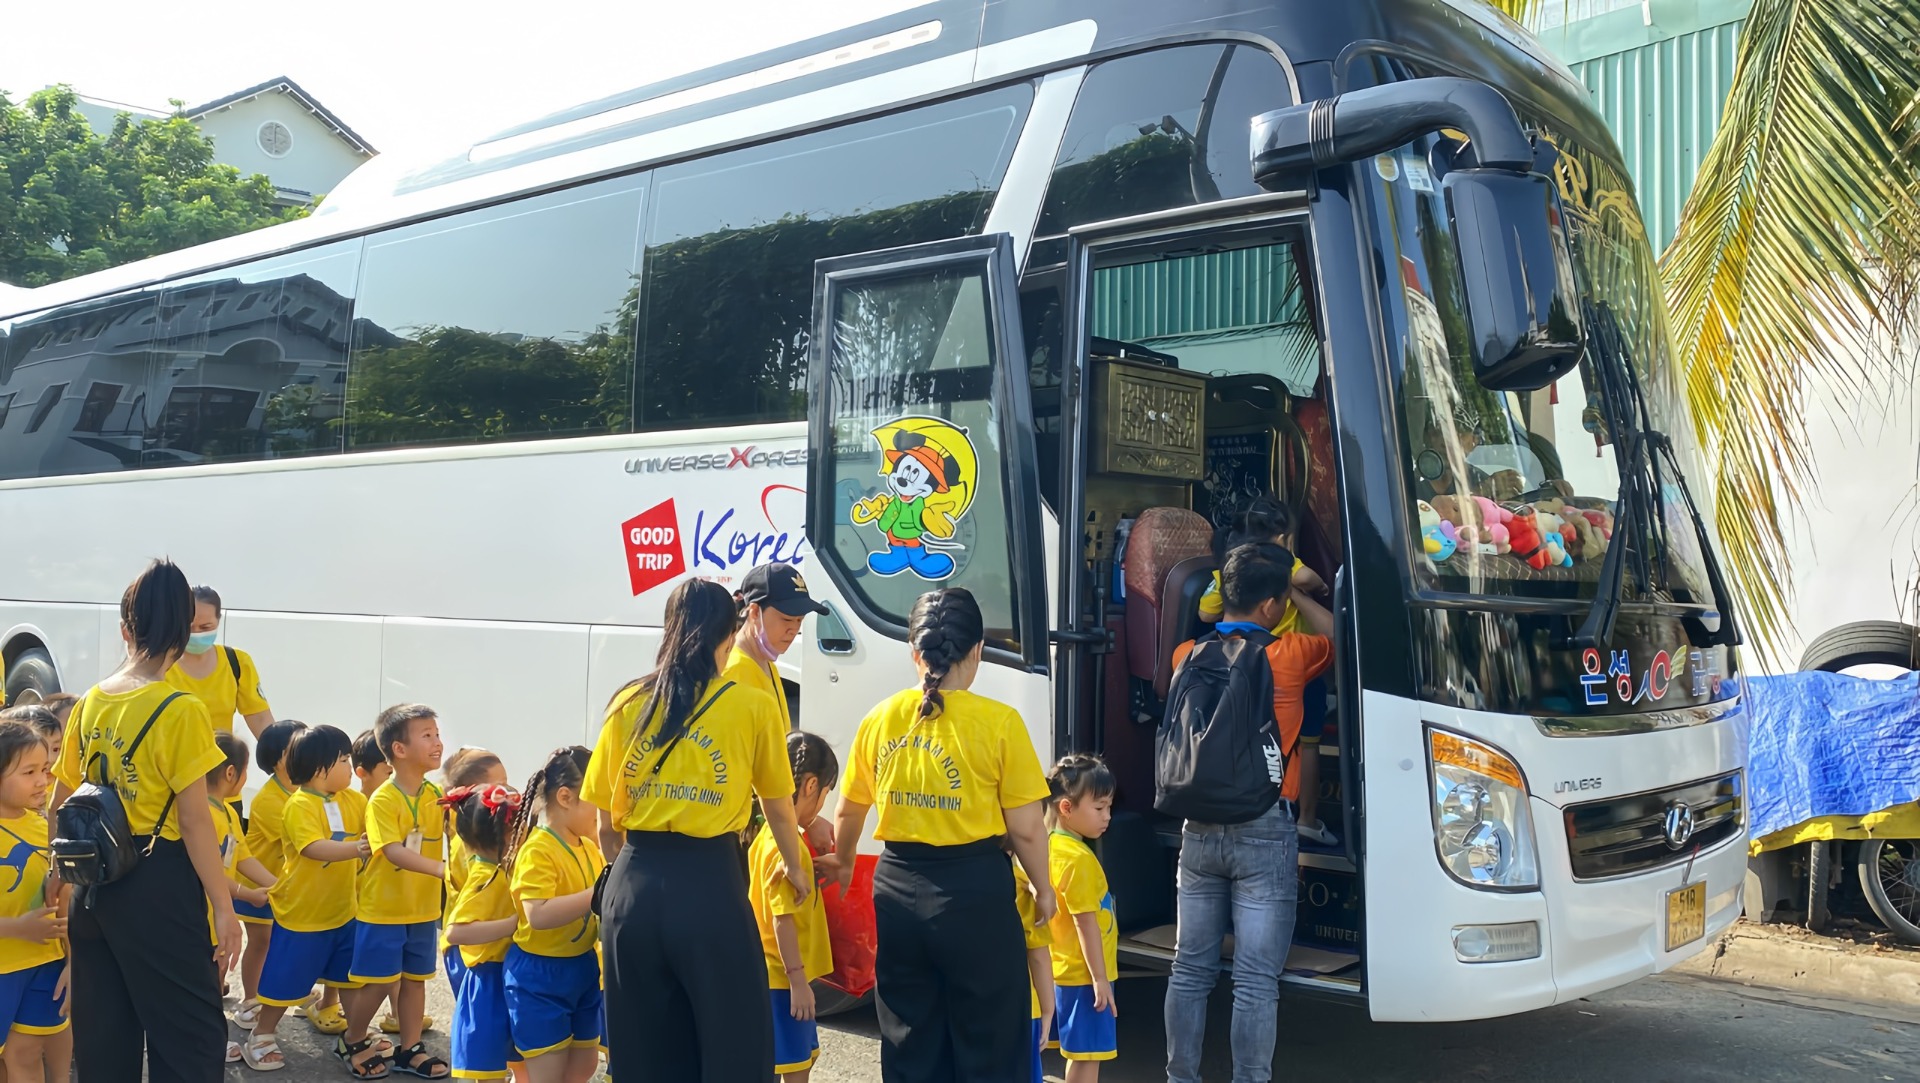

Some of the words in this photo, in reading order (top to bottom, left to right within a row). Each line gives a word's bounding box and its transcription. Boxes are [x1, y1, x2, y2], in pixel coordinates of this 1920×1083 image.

[630, 527, 675, 545] GOOD
[636, 553, 673, 570] TRIP
[1579, 647, 1633, 706] 은성
[709, 749, 728, 784] NON
[941, 756, 962, 790] NON
[1262, 744, 1283, 788] NIKE
[698, 788, 724, 807] MINH
[938, 795, 962, 811] MINH
